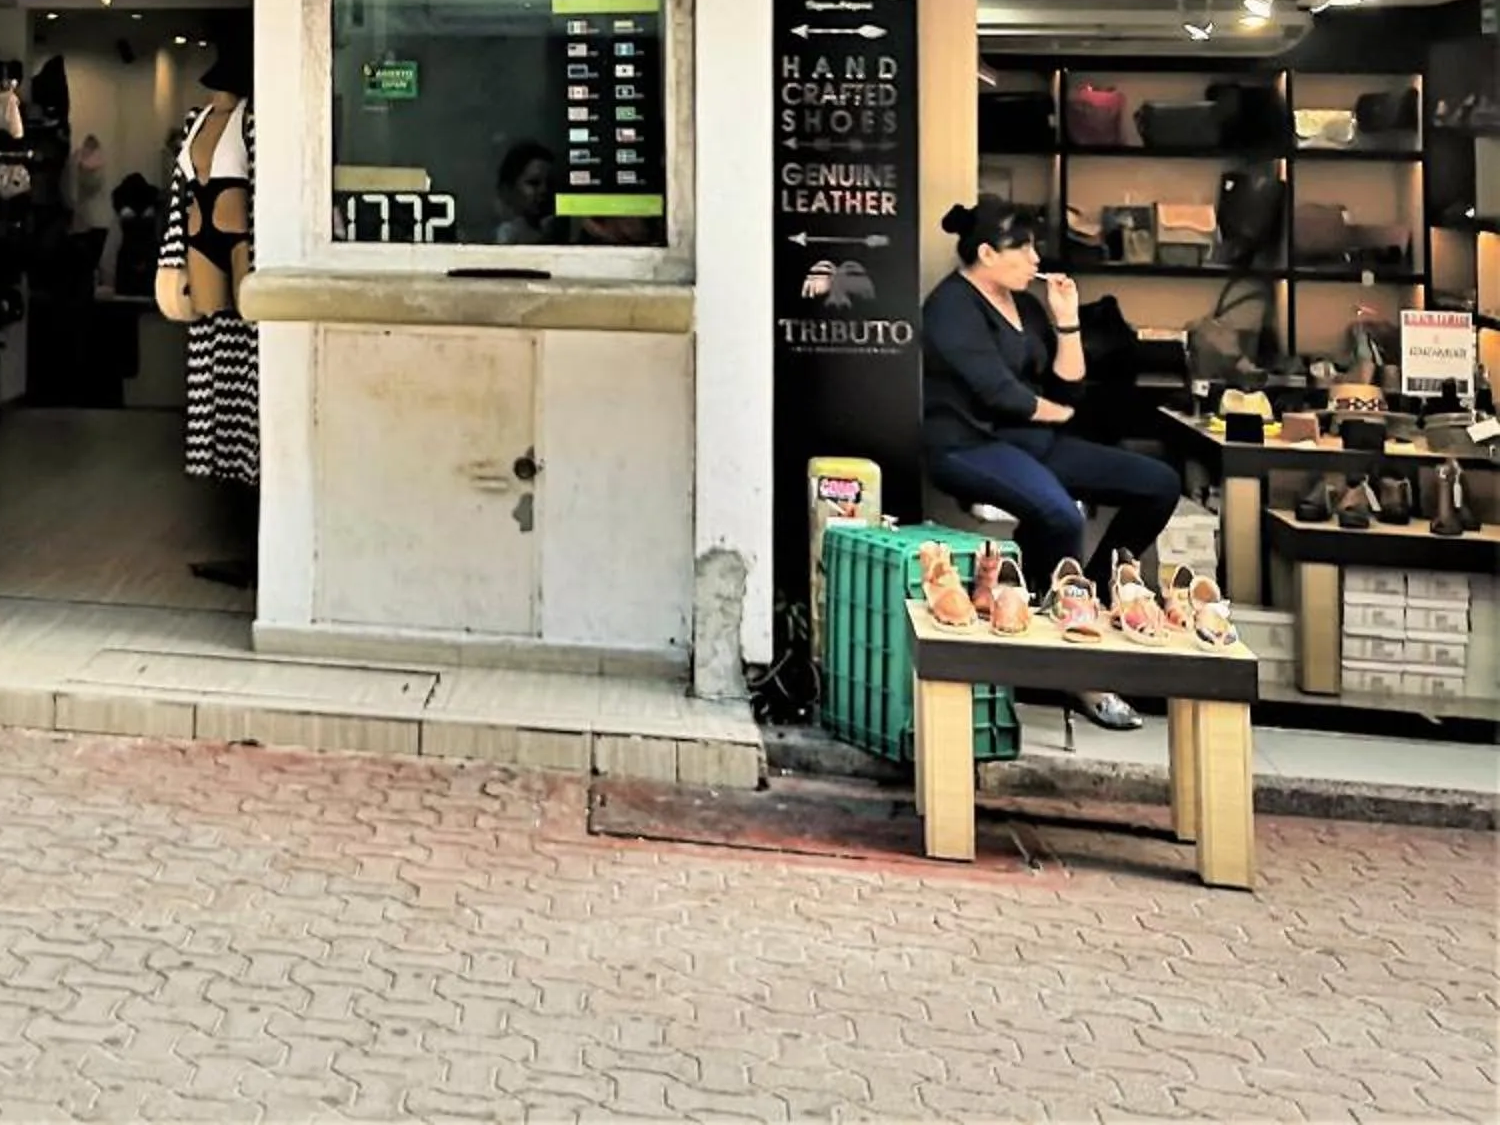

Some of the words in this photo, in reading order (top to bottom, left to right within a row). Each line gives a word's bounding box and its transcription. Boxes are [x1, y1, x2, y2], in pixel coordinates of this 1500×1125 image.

[781, 55, 899, 79] HAND
[781, 82, 899, 106] CRAFTED
[780, 109, 899, 134] SHOES
[781, 162, 898, 187] GENUINE
[781, 188, 898, 215] LEATHER
[777, 318, 914, 346] TRIBUTO
